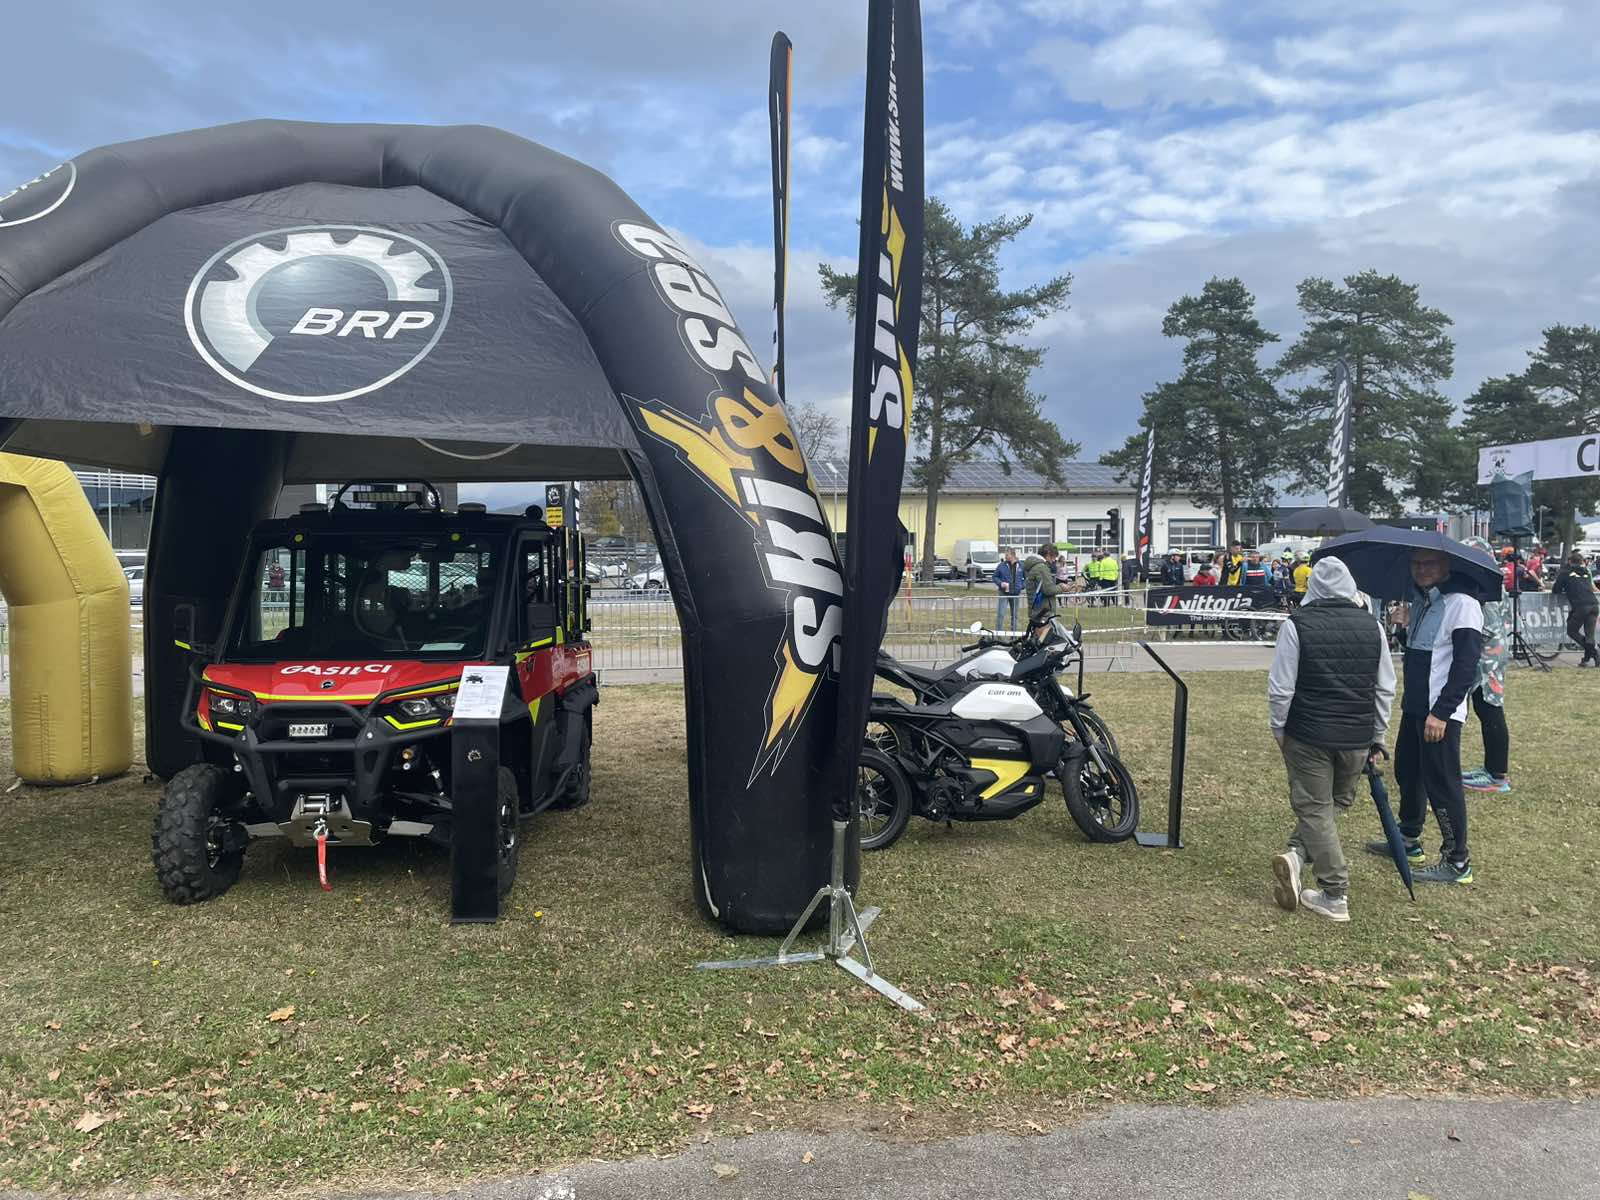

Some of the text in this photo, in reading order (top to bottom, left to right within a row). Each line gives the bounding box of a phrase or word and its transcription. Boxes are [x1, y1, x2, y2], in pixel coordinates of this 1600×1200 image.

[289, 307, 435, 339] BRP
[1576, 438, 1600, 472] C
[1178, 593, 1253, 611] vittoria
